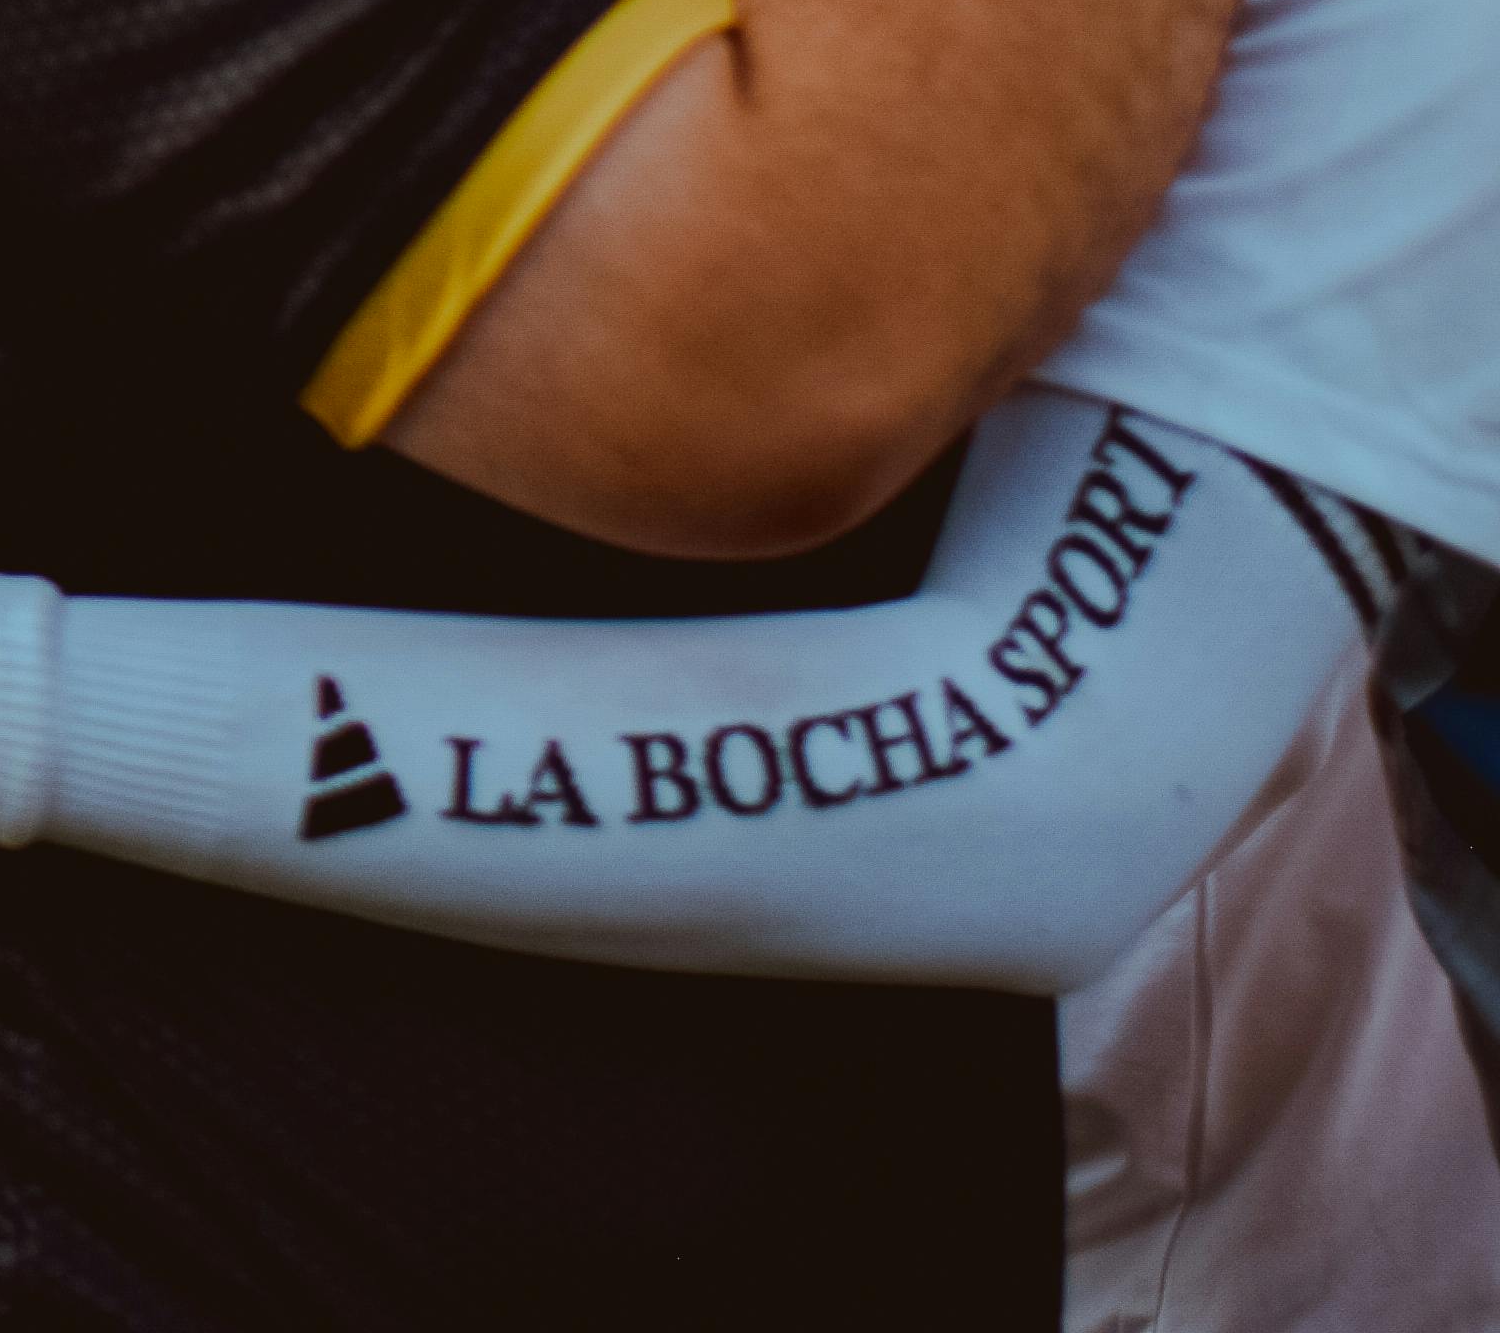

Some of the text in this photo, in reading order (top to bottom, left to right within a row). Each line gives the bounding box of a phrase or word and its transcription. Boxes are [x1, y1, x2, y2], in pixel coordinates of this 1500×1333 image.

[440, 405, 1198, 828] LA BOCHA SPORT
